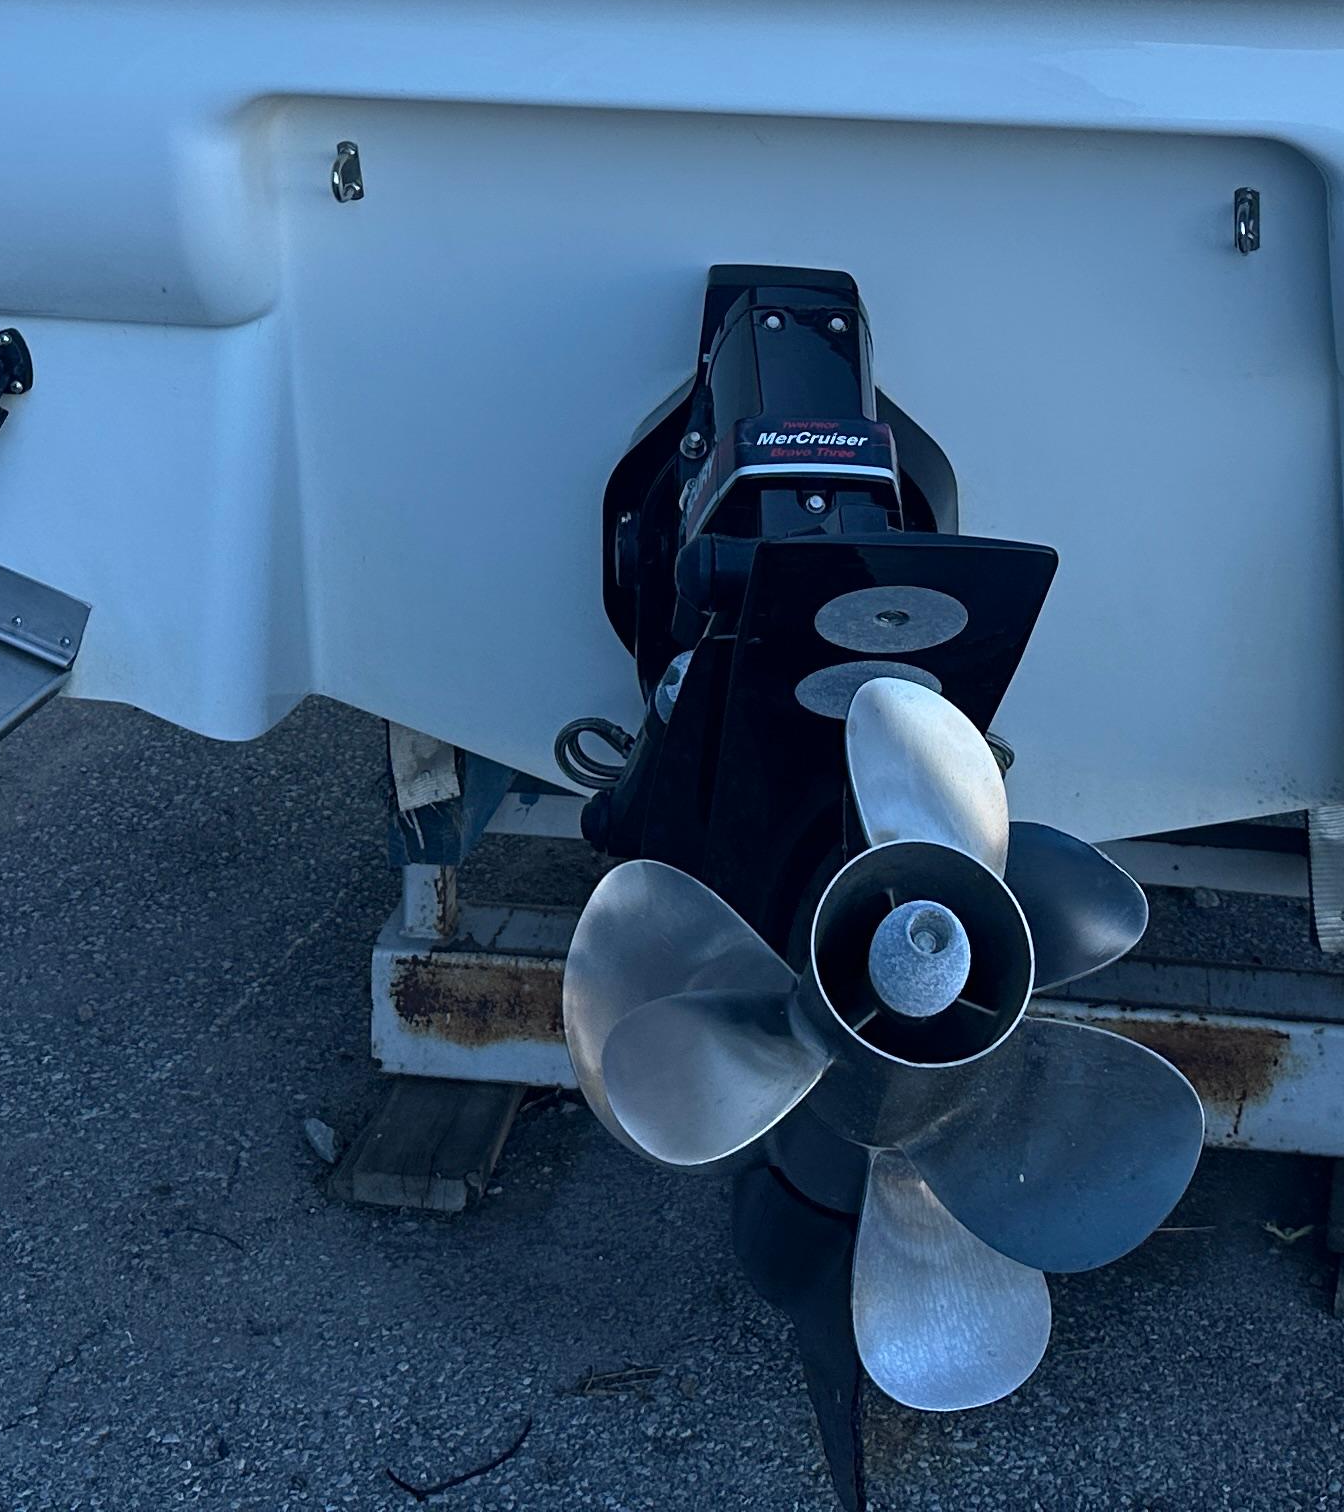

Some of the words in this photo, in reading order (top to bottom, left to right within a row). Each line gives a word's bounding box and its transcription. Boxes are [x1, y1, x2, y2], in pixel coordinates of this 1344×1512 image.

[756, 431, 869, 447] MerCruiser
[771, 448, 812, 457] Bravo
[817, 447, 856, 458] Three
